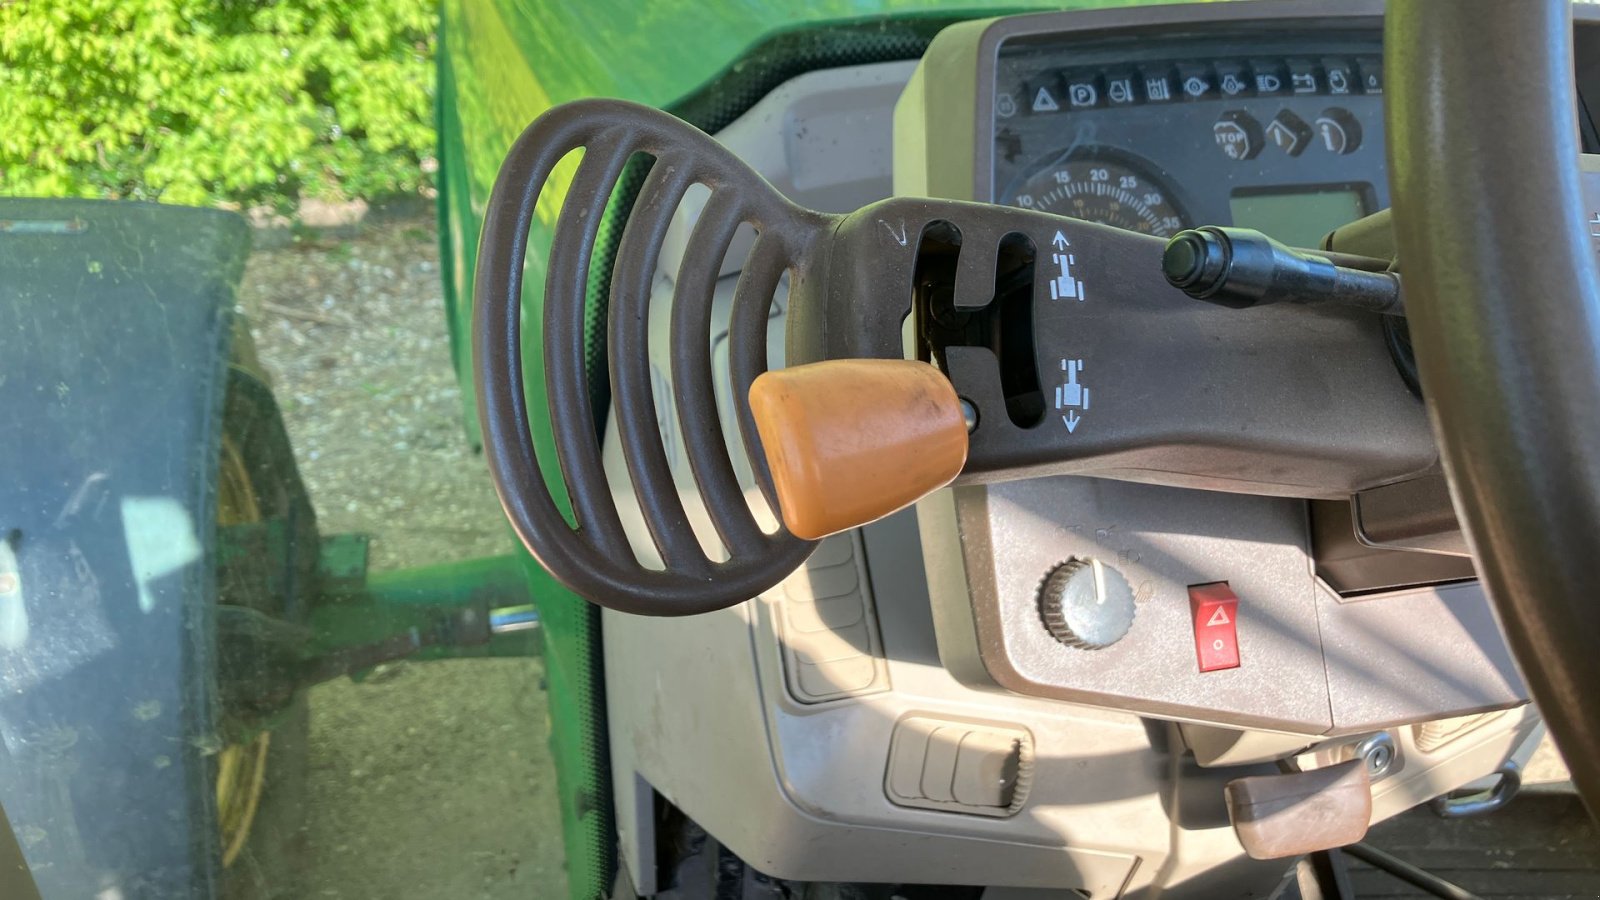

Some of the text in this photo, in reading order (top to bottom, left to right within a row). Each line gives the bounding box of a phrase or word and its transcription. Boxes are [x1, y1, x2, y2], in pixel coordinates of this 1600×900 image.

[1054, 171, 1071, 184] 15
[1090, 168, 1109, 181] 20
[1119, 176, 1137, 188] 25
[1016, 194, 1033, 208] 10
[1143, 193, 1162, 206] 30
[1162, 216, 1181, 229] 35
